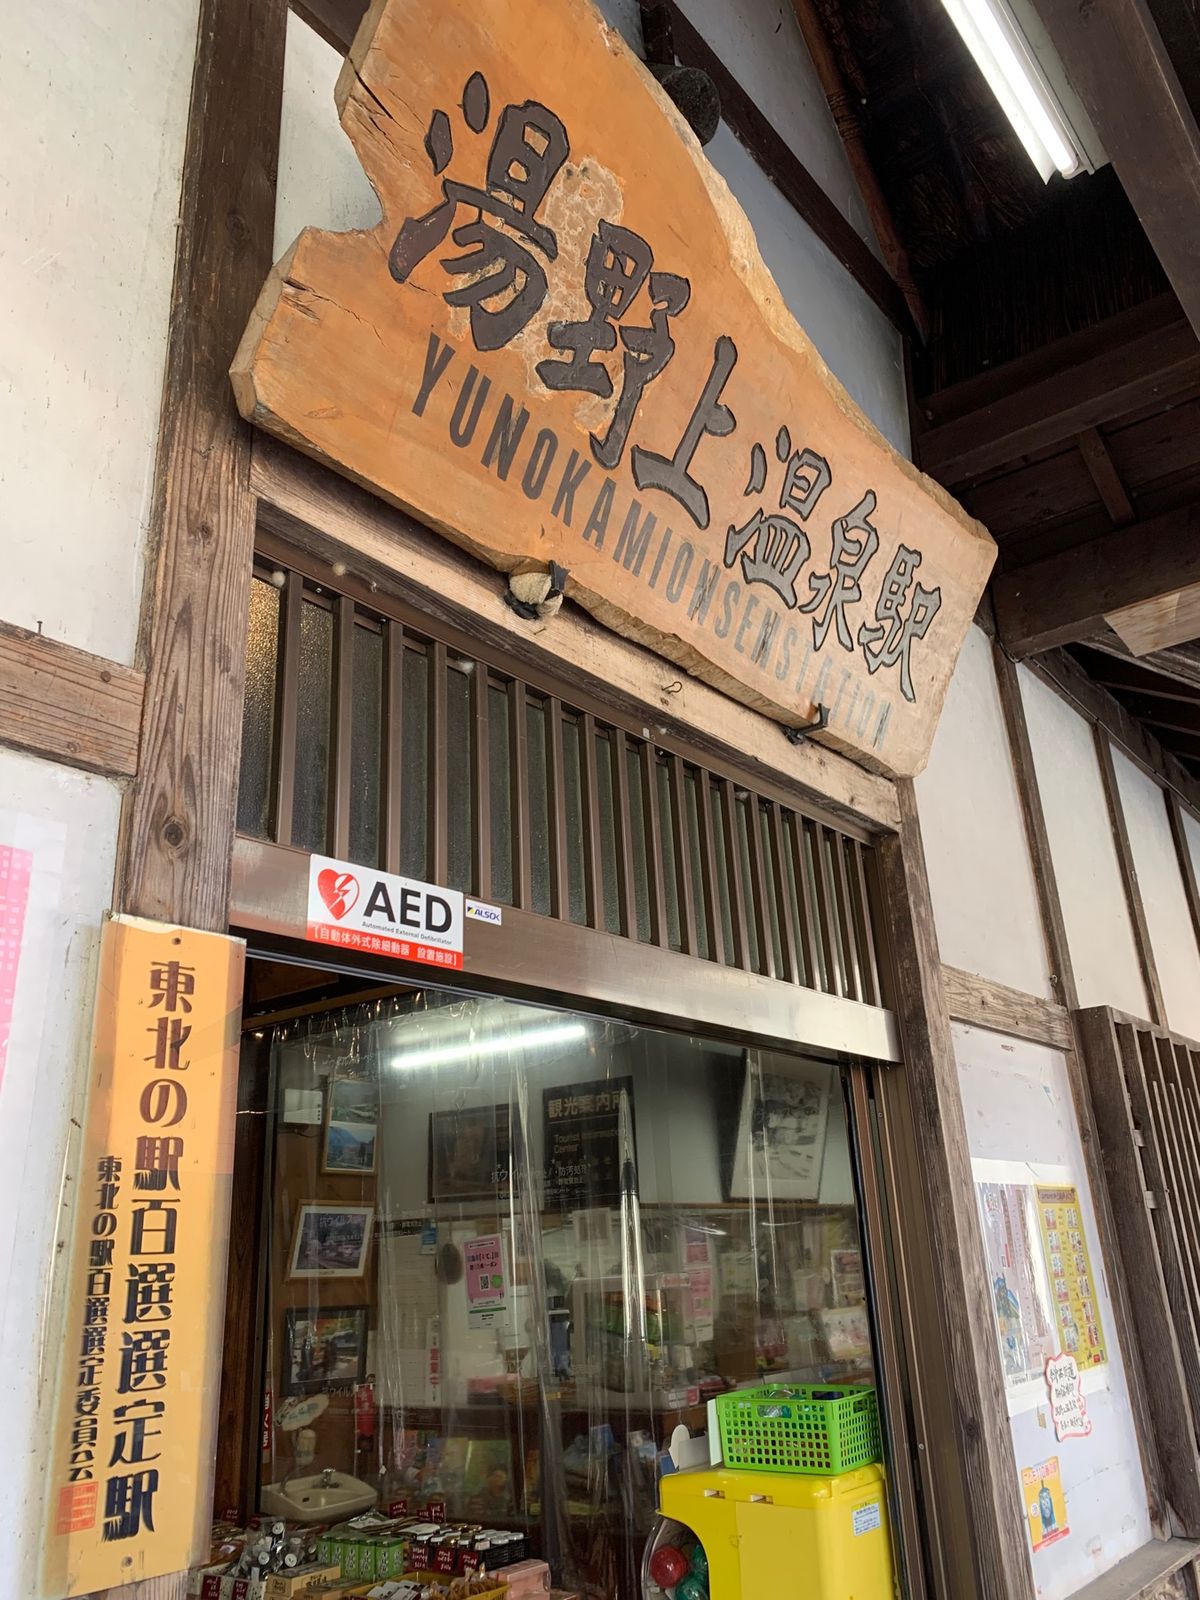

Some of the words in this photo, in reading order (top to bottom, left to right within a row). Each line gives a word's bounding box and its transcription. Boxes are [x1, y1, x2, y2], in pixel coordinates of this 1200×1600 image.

[388, 70, 943, 703] 湯野上温泉駅
[362, 922, 395, 934] Automated
[395, 928, 420, 939] External
[420, 933, 452, 945] Defibrillator
[363, 881, 453, 934] AED
[474, 907, 500, 921] ALSOK
[69, 1156, 122, 1482] 東北の駅百選選定委員会
[101, 960, 196, 1543] 東北の駅百選選定駅
